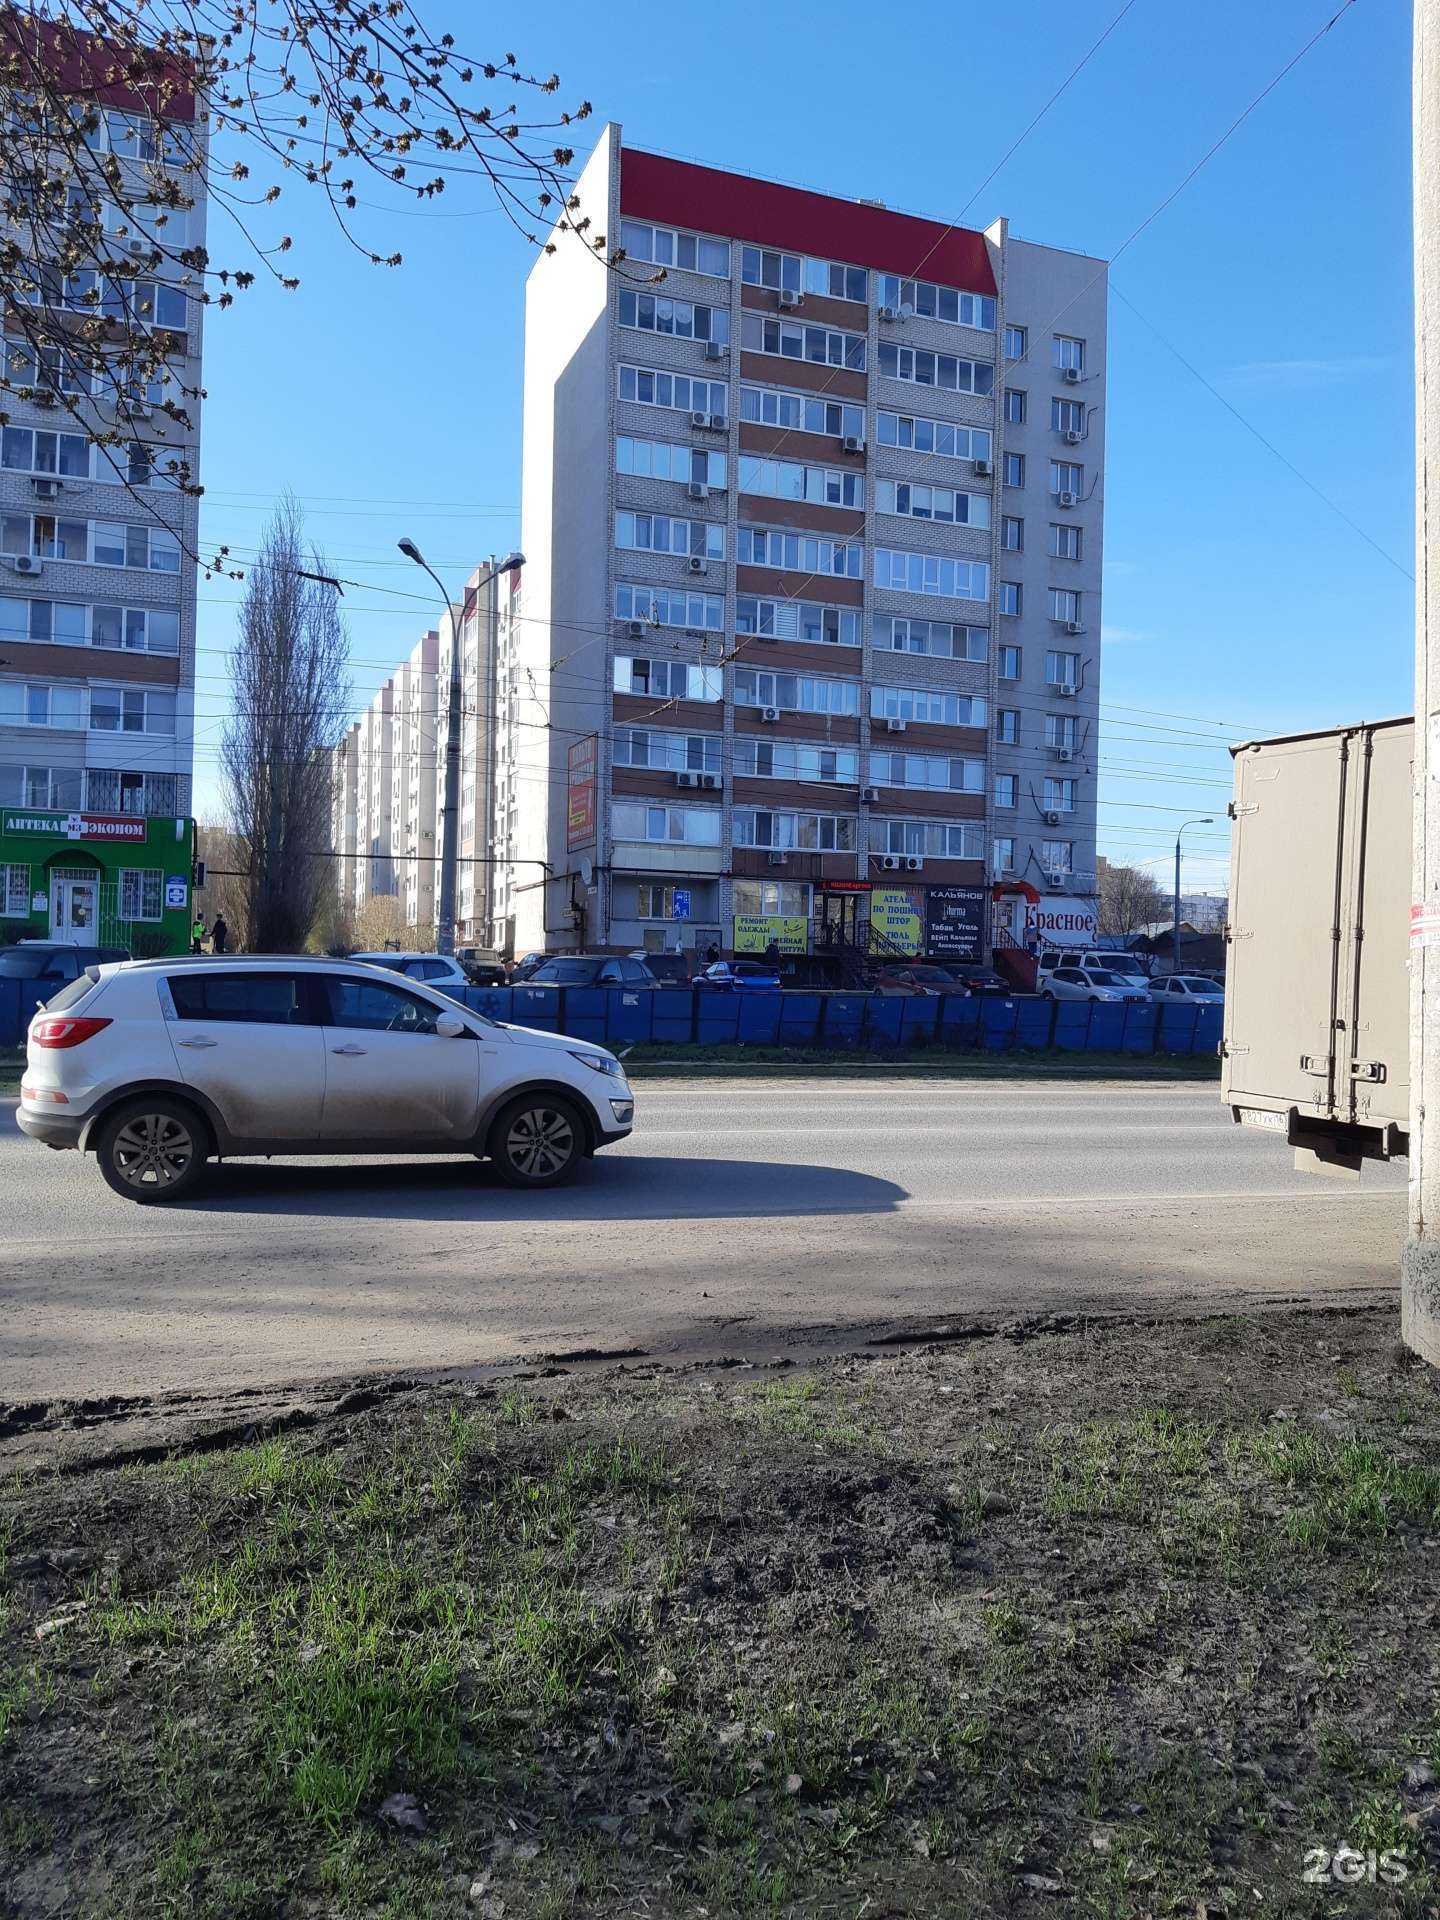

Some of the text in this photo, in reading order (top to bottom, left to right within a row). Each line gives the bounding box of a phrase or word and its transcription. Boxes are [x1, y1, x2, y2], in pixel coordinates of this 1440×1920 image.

[6, 818, 60, 832] АПТЕКА
[89, 822, 144, 836] ЭКОНОМ
[930, 890, 983, 900] КАЛЬЯНОВ
[872, 905, 885, 913] ПО
[740, 917, 768, 925] РЕМОНТ
[886, 916, 911, 925] ШТОР
[1024, 905, 1093, 931] Красное
[930, 922, 979, 932] Табак Уголь
